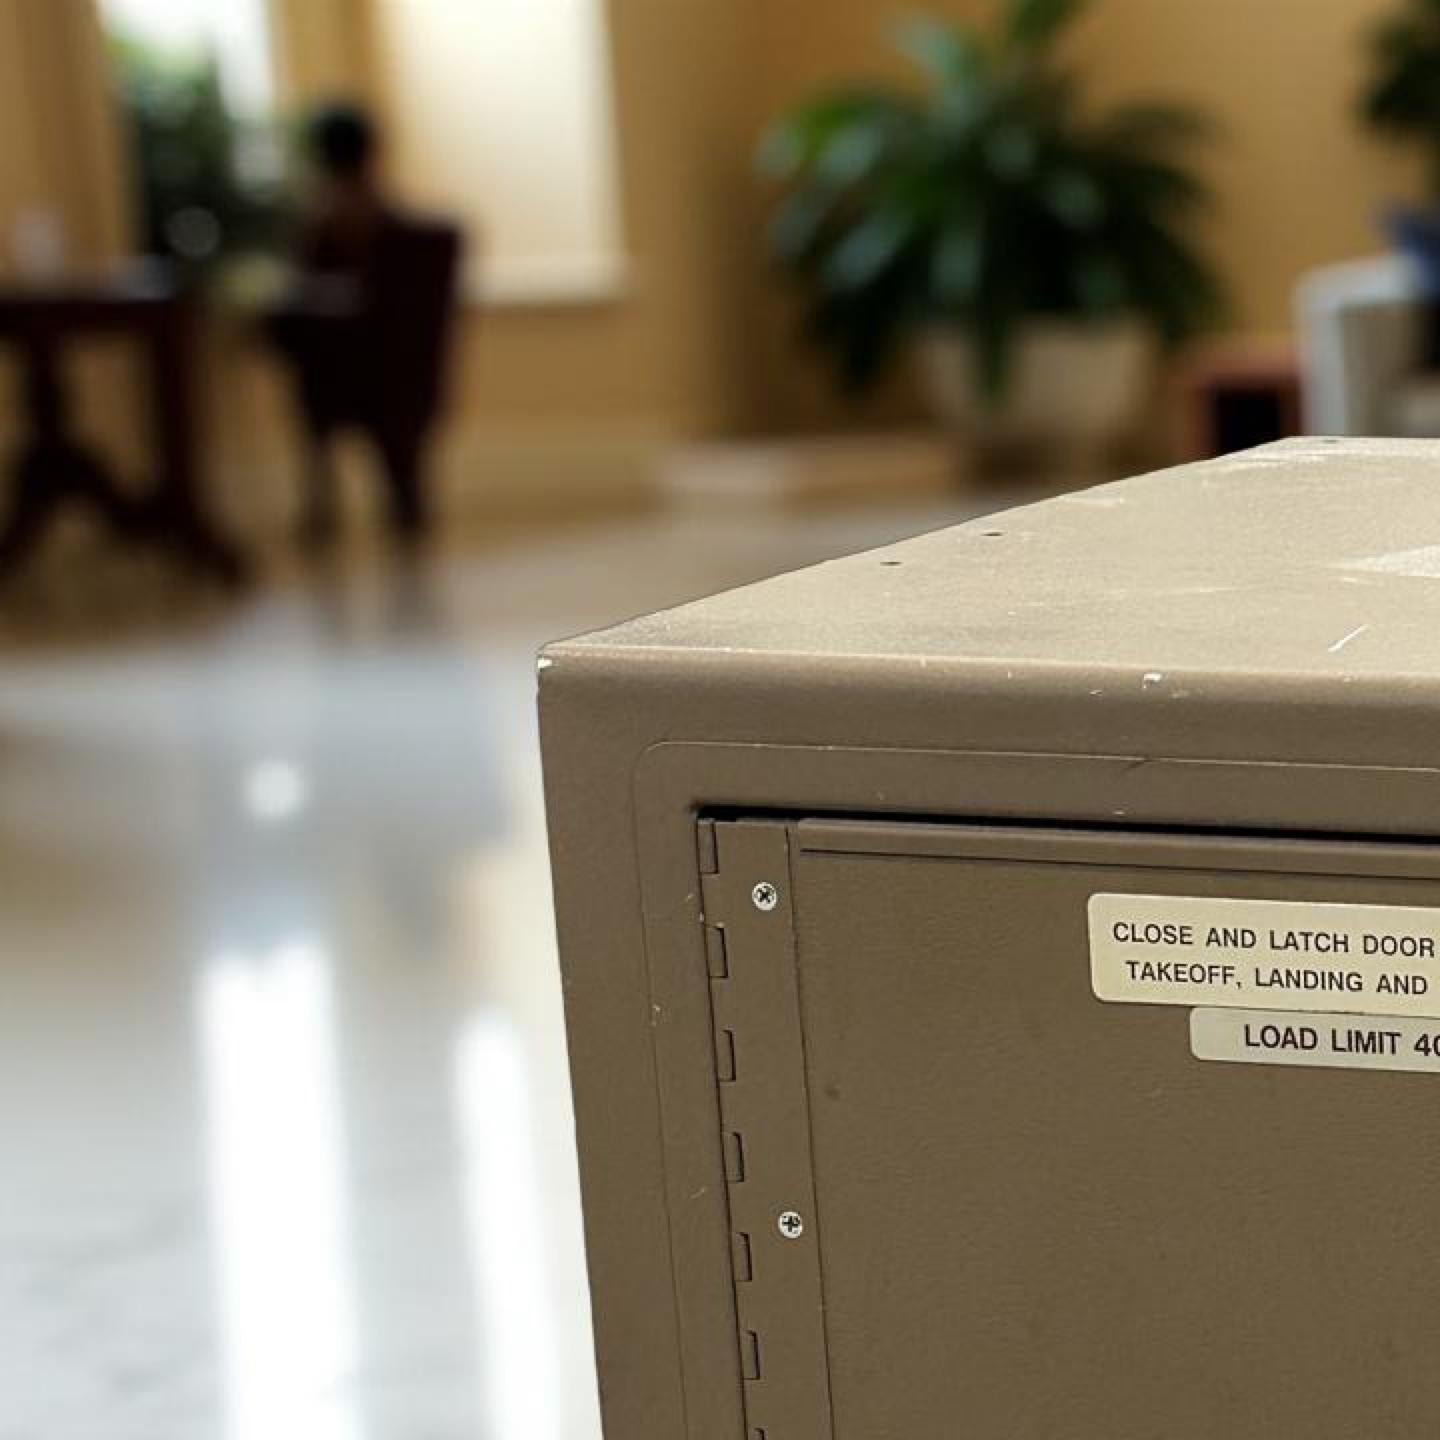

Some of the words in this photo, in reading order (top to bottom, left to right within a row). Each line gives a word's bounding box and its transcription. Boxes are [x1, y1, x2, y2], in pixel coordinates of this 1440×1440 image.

[1113, 921, 1194, 946] CLOSE
[1205, 927, 1257, 949] AND
[1269, 929, 1349, 953] LATCH
[1362, 933, 1435, 959] DOOR
[1124, 959, 1242, 990] TAKEOFF,
[1255, 967, 1363, 993] LANDING
[1375, 973, 1429, 995] AND
[1243, 1023, 1319, 1051] LOAD
[1331, 1027, 1403, 1056] LIMIT
